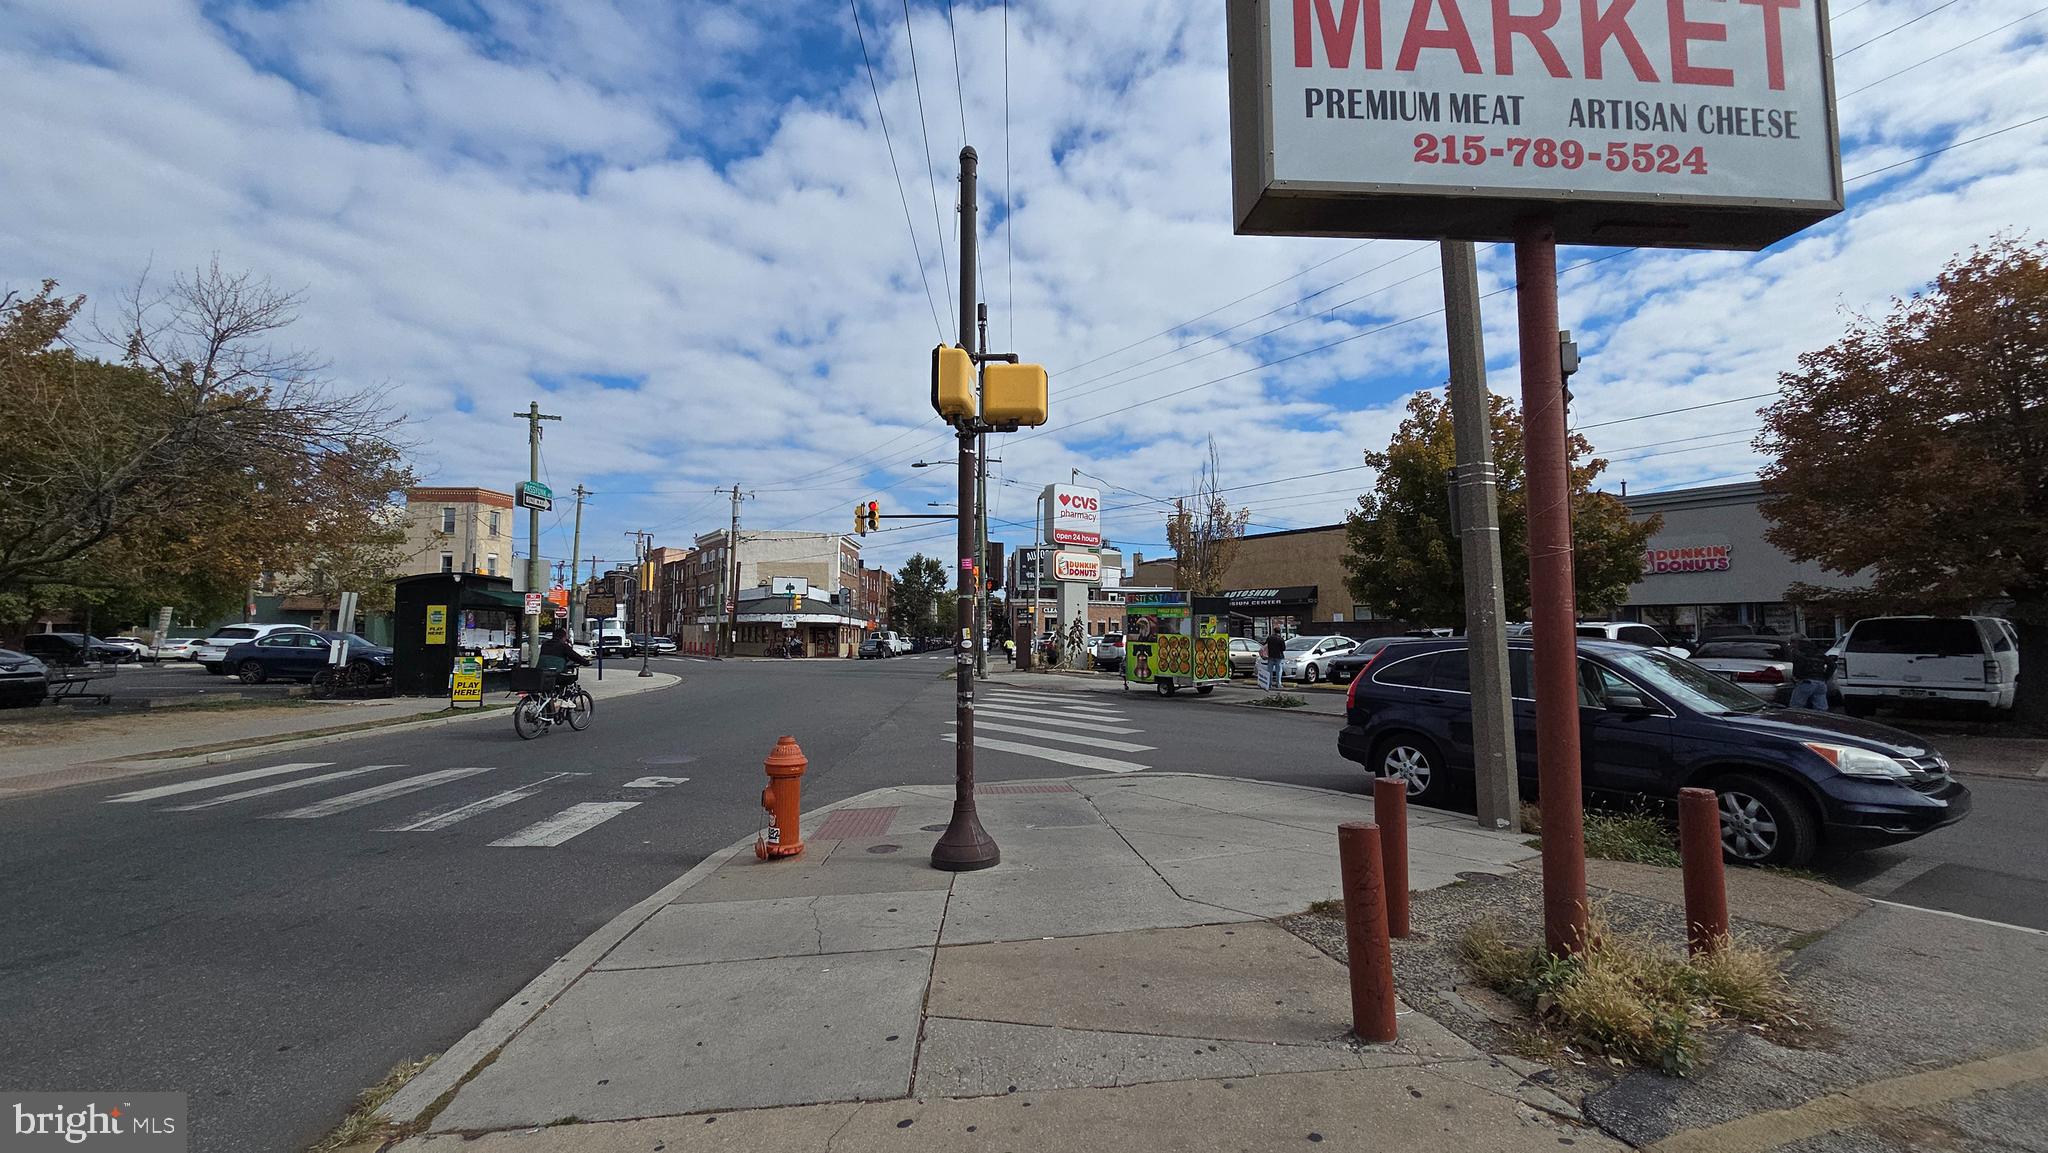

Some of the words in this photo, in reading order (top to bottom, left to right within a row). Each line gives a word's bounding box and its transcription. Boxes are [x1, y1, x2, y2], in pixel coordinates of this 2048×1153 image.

[1292, 0, 1801, 91] MARKET
[1304, 87, 1441, 122] PREMIUM
[1449, 92, 1525, 126] MEAT
[1568, 98, 1688, 133] ARTISAN
[1697, 104, 1801, 140] CHEESE
[1413, 132, 1708, 175] 215-789-5524
[1071, 495, 1098, 511] CVS
[1060, 509, 1097, 522] pharmacy
[1056, 532, 1072, 541] open
[1072, 533, 1081, 541] 24
[1081, 534, 1099, 543] hours
[1656, 557, 1729, 572] DONUTS
[1069, 568, 1097, 577] DONUTS
[1223, 589, 1280, 598] AUTOSHOW
[456, 681, 480, 689] PLAY
